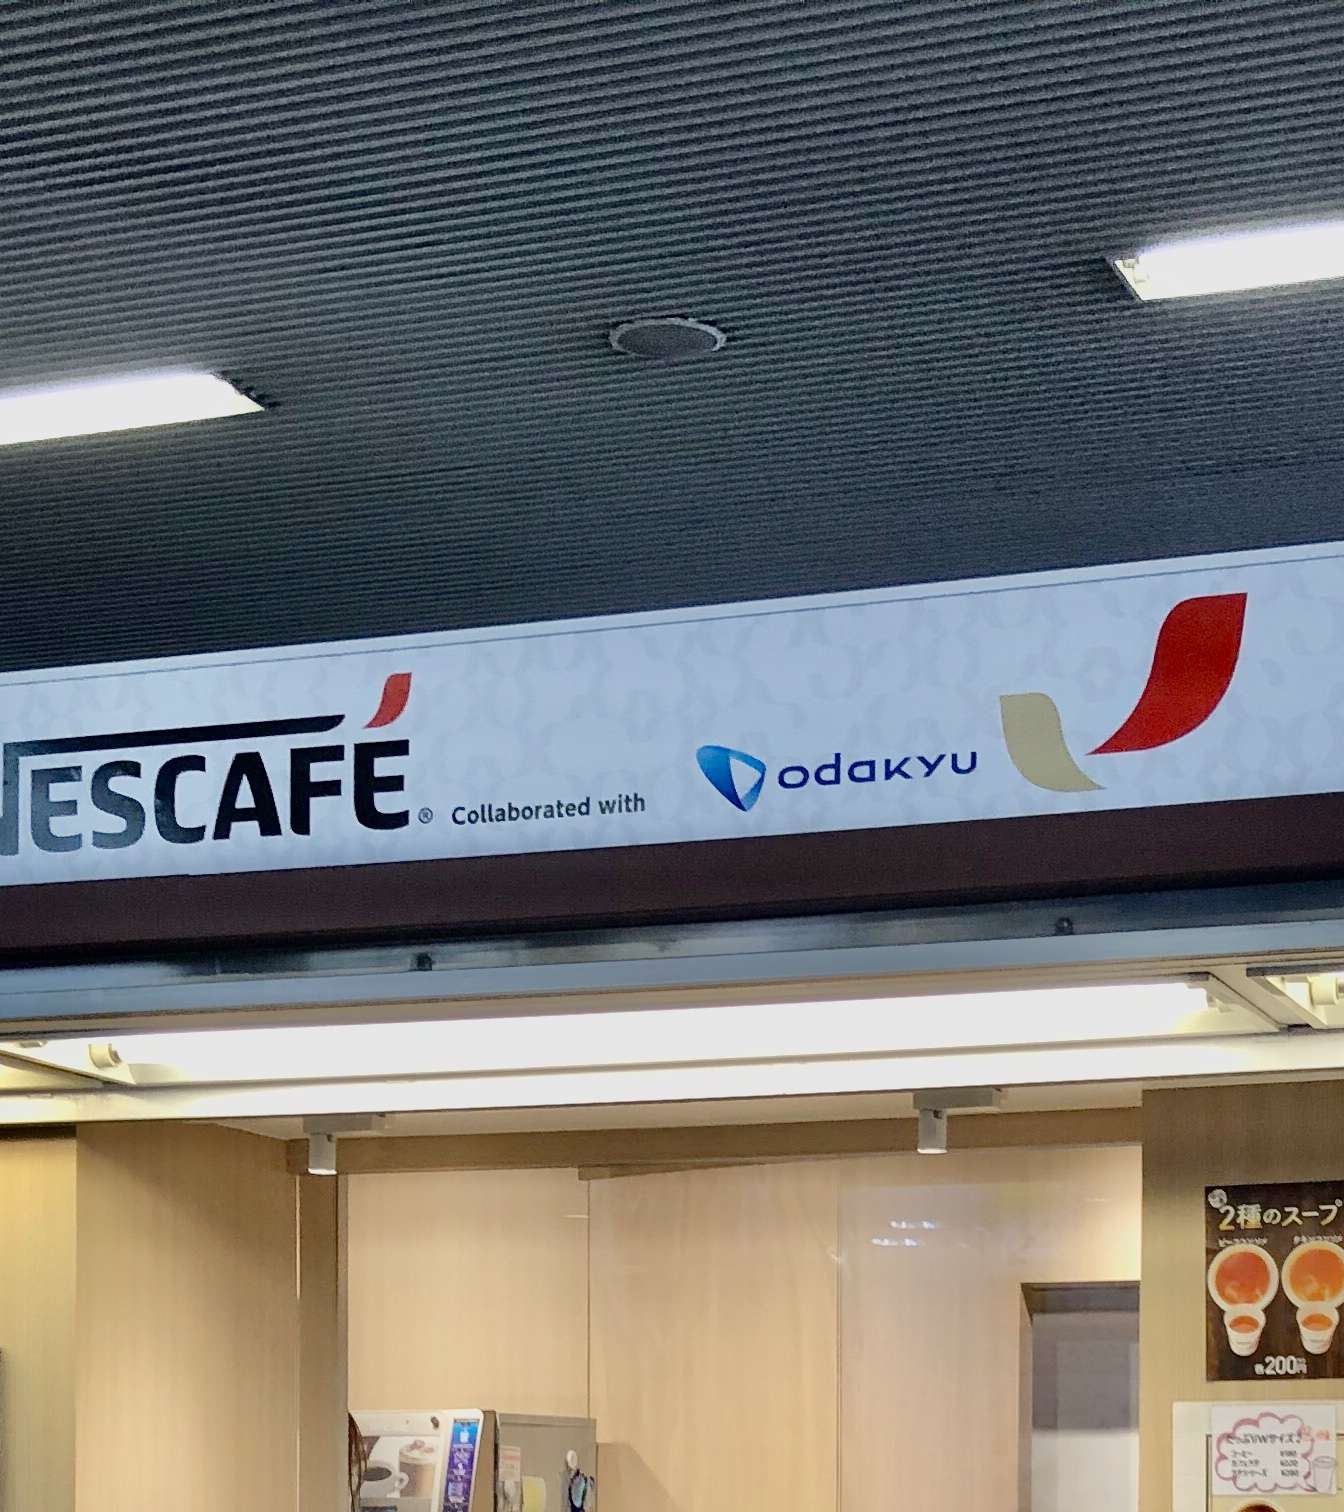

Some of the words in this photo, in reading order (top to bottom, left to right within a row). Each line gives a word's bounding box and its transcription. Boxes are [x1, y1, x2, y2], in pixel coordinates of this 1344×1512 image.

[450, 796, 594, 827] Collaborated
[598, 790, 648, 819] with
[1218, 1199, 1343, 1232] 2種のスープ
